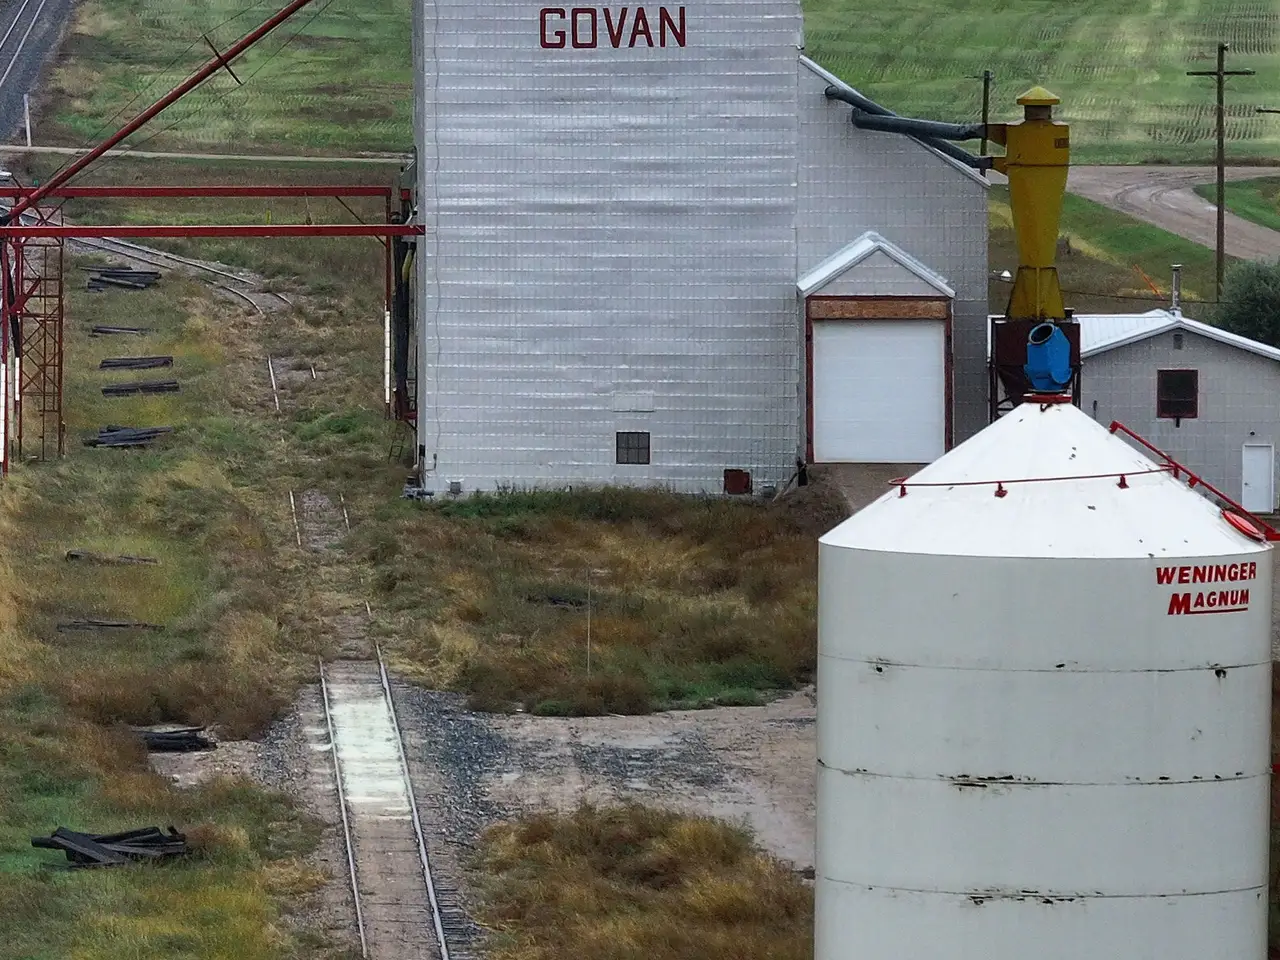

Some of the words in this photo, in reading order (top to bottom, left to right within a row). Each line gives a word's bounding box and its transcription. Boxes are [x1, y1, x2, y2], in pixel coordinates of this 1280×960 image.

[539, 7, 687, 49] GOVAN
[1156, 561, 1257, 585] WENINGER
[1167, 588, 1250, 615] MAGNUM
